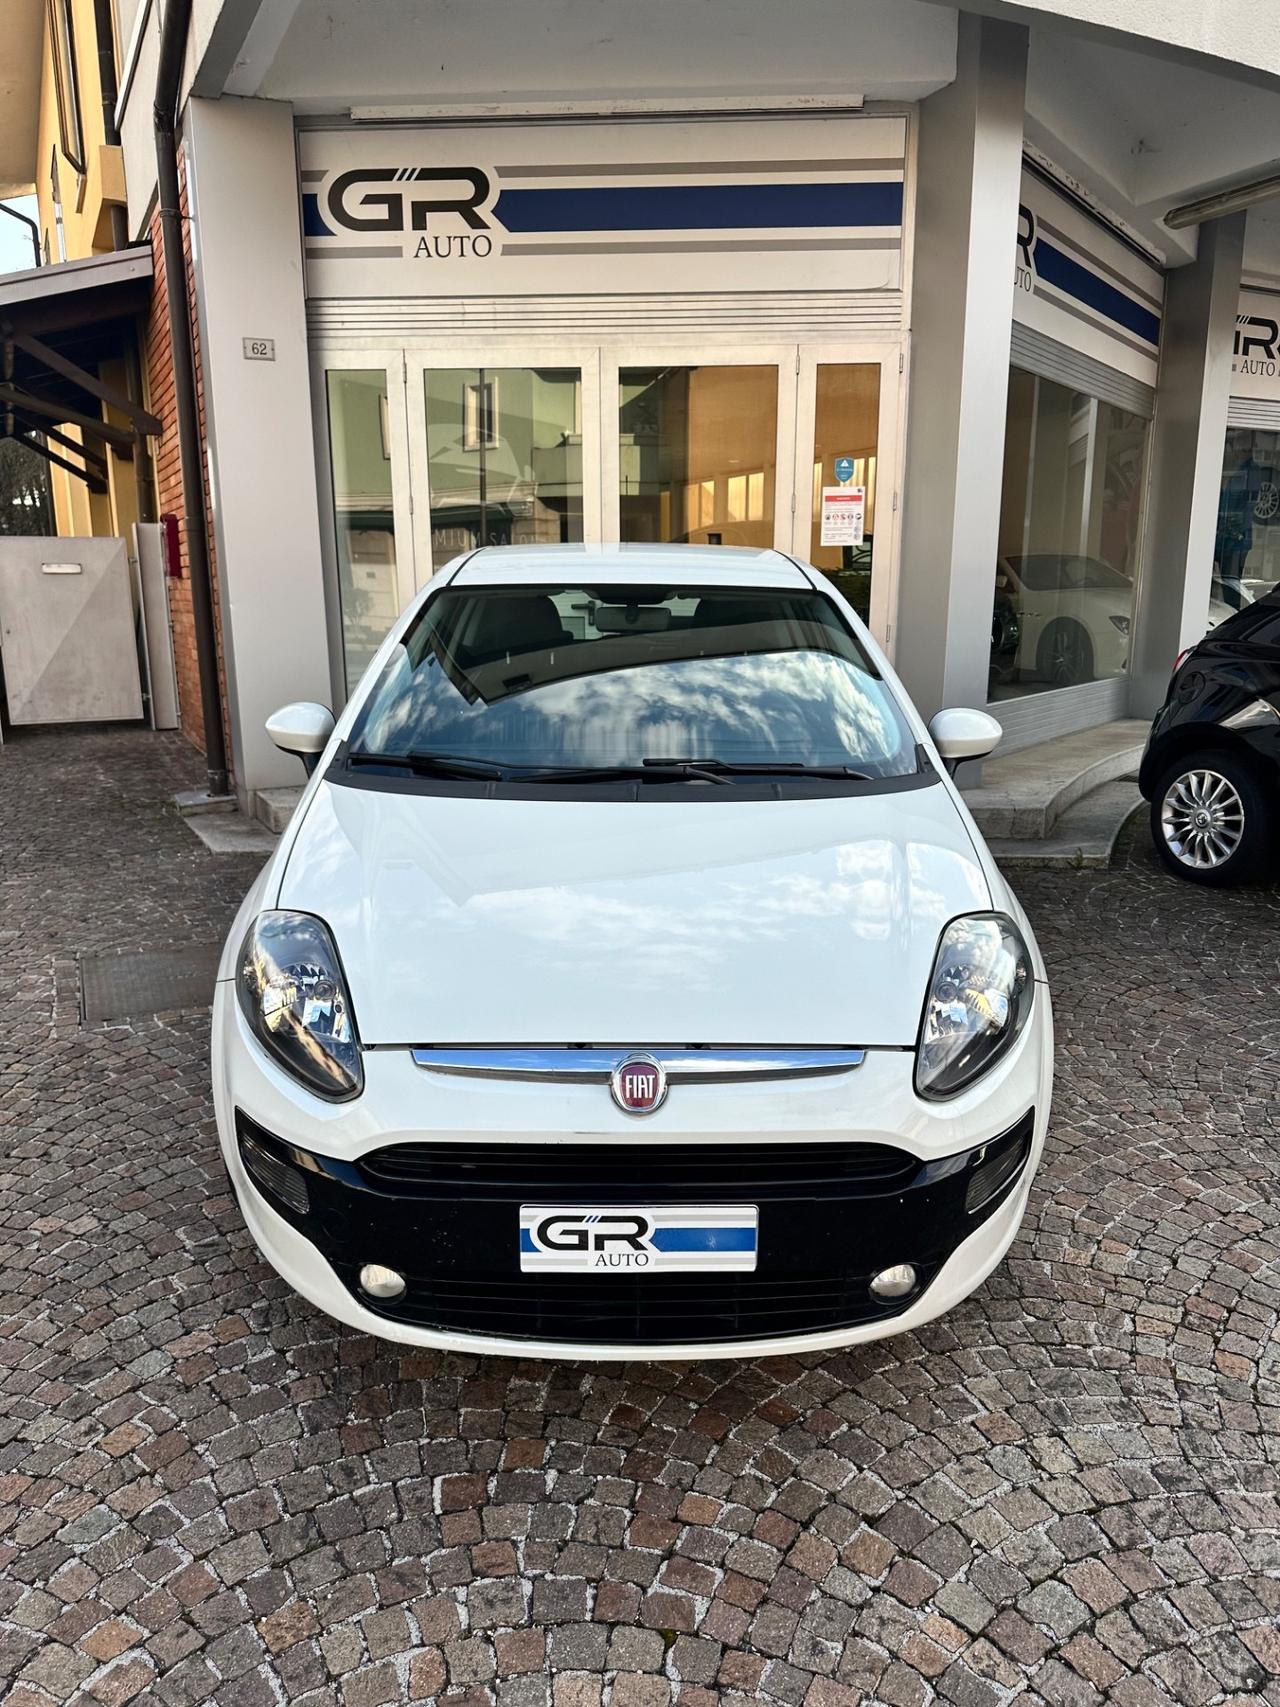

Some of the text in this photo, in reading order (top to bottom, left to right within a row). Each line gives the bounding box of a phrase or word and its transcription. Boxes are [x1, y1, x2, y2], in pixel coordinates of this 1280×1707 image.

[328, 166, 491, 231] GR
[413, 234, 493, 259] AUTO
[1017, 203, 1034, 269] R
[251, 342, 268, 356] 62
[1233, 315, 1279, 360] R
[1240, 359, 1276, 377] AUTO
[433, 528, 481, 549] MIUM
[625, 1074, 655, 1099] FIAT
[537, 1215, 649, 1251] GR
[595, 1253, 649, 1267] AUTO
